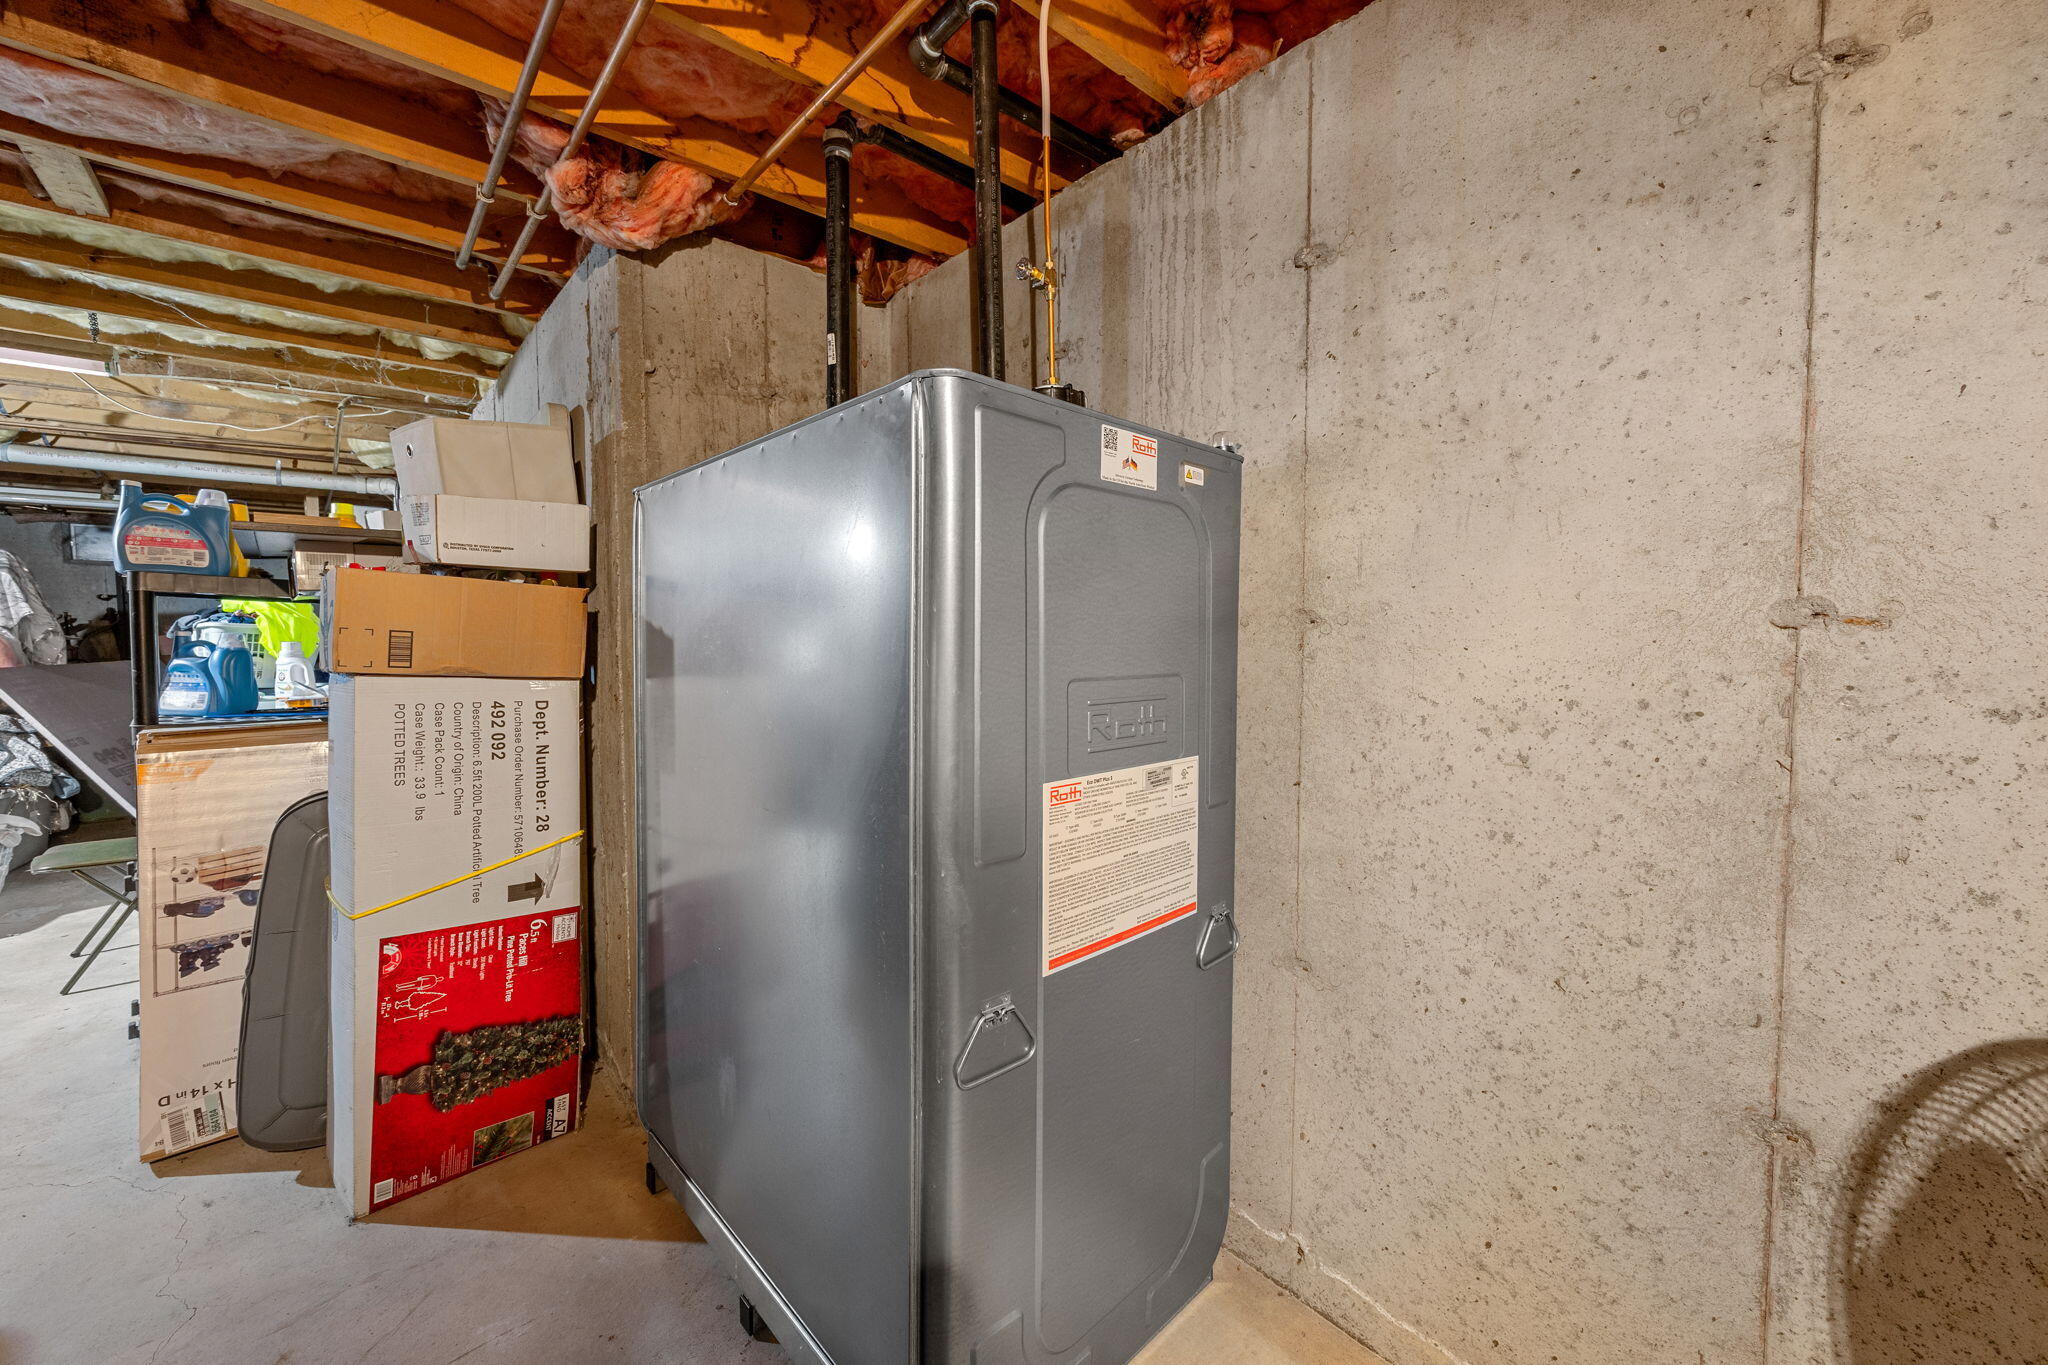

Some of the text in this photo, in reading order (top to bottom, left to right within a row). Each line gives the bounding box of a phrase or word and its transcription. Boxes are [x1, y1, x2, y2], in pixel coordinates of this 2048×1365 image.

[1132, 438, 1156, 454] Roth
[415, 703, 425, 728] Case
[434, 703, 444, 727] Case
[1087, 705, 1167, 743] Roth
[434, 730, 444, 754] Pack
[491, 701, 506, 760] 492 092
[394, 704, 405, 786] POTTED TREES
[451, 702, 463, 815] Country of Origin: China
[434, 756, 444, 788] Count:
[514, 701, 523, 859] Purchase Order Number: 5710648
[533, 701, 549, 832] Dept. Number: 28
[415, 777, 426, 799] 33.9
[1050, 786, 1082, 803] Roth
[415, 806, 425, 821] lbs
[469, 702, 482, 903] Description: 6.5ft 200L Potted Artificil Tree
[518, 933, 528, 967] Paces Hill
[505, 936, 516, 1002] Pine Potted Pre-Lit Tree
[158, 1095, 171, 1107] D
[190, 1085, 209, 1098] 14
[554, 1120, 566, 1132] A7
